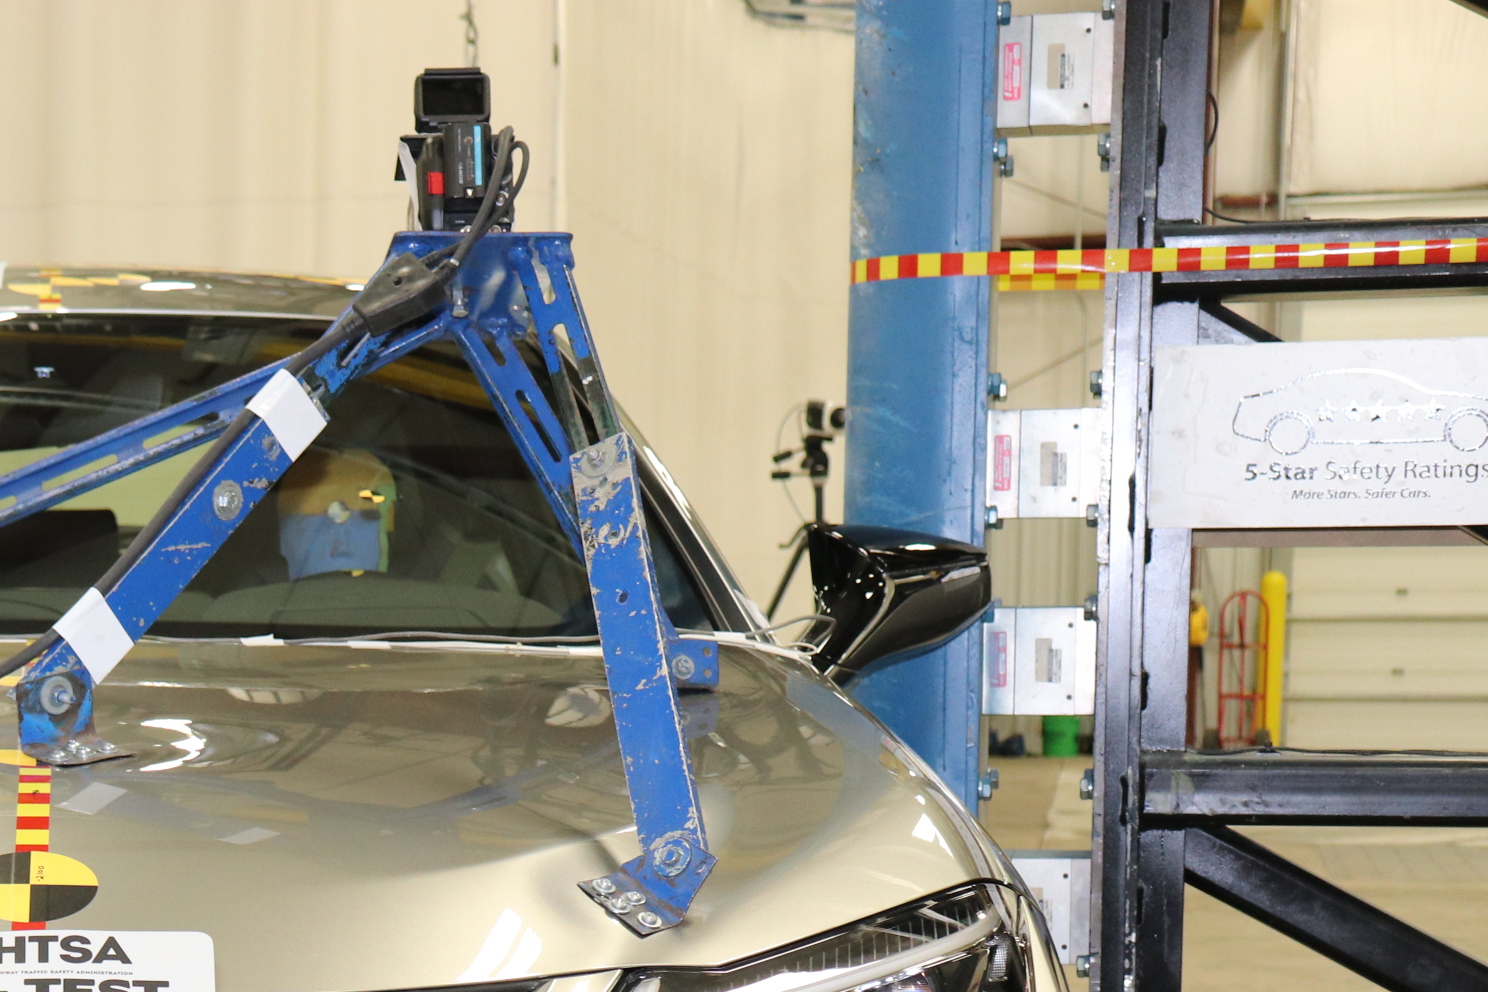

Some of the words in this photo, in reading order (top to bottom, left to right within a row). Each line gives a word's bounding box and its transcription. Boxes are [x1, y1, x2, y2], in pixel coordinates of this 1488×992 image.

[1243, 462, 1318, 482] 5-Star
[1323, 459, 1397, 484] Safety
[1403, 458, 1488, 484] Ratings
[1291, 489, 1324, 499] More
[1327, 488, 1361, 499] Stars.
[1364, 488, 1397, 499] Safer
[1400, 487, 1431, 499] Cars.
